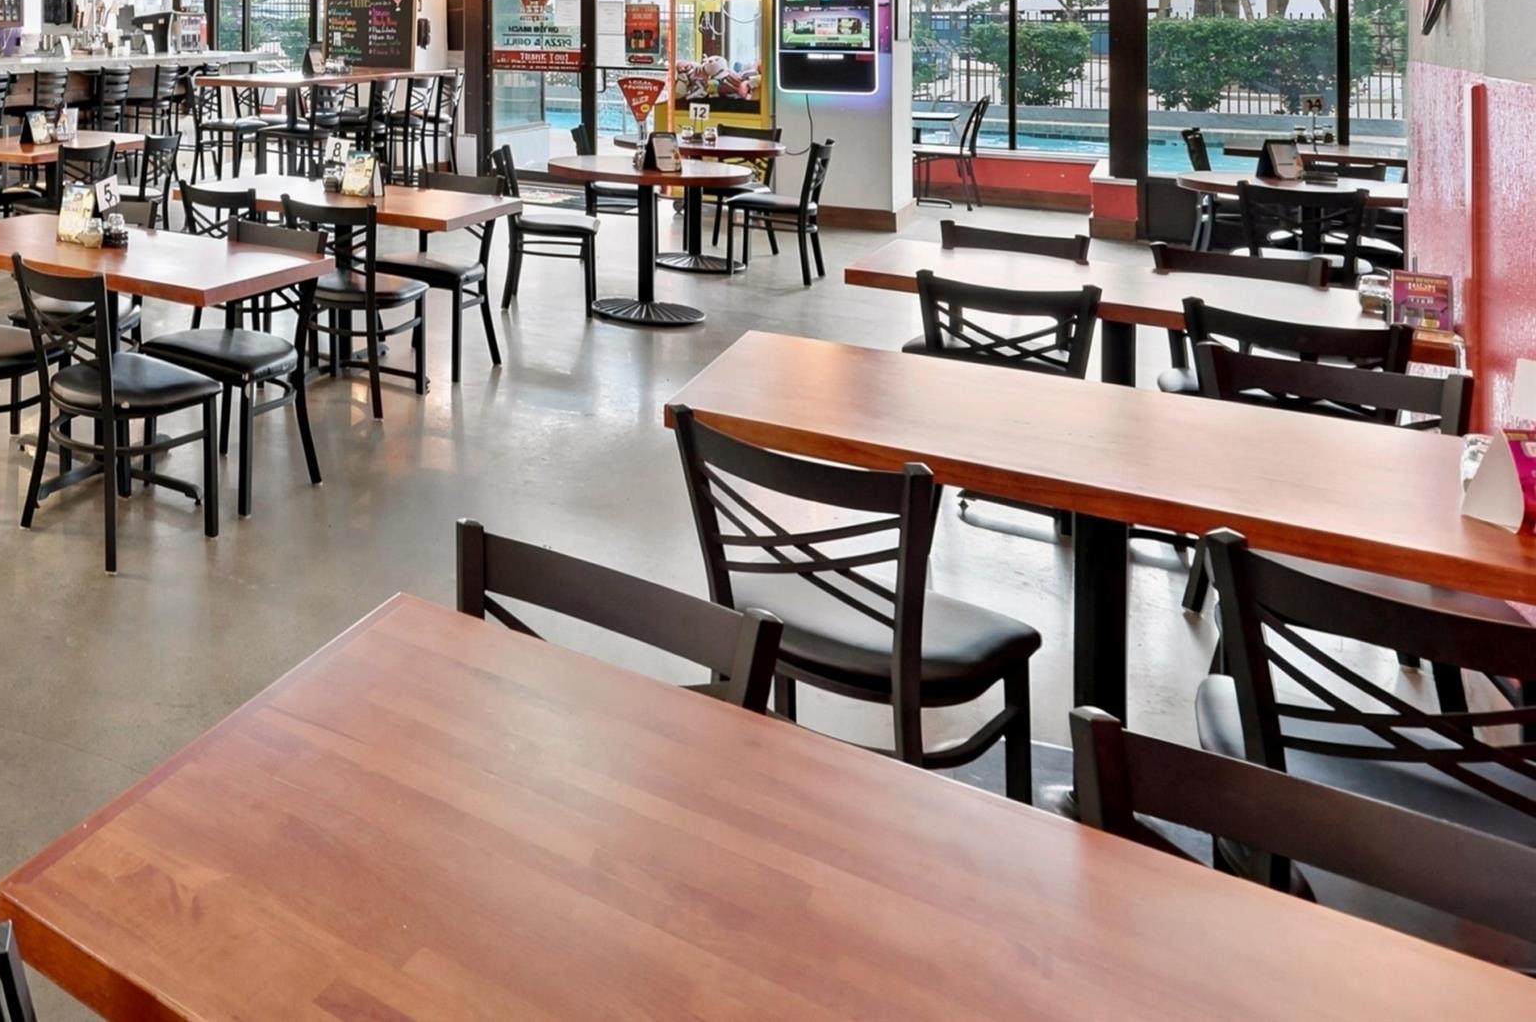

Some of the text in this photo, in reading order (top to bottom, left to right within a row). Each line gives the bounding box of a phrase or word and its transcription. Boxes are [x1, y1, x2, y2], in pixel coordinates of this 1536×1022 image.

[693, 106, 707, 118] 12
[332, 142, 342, 157] 8
[103, 183, 113, 203] 5
